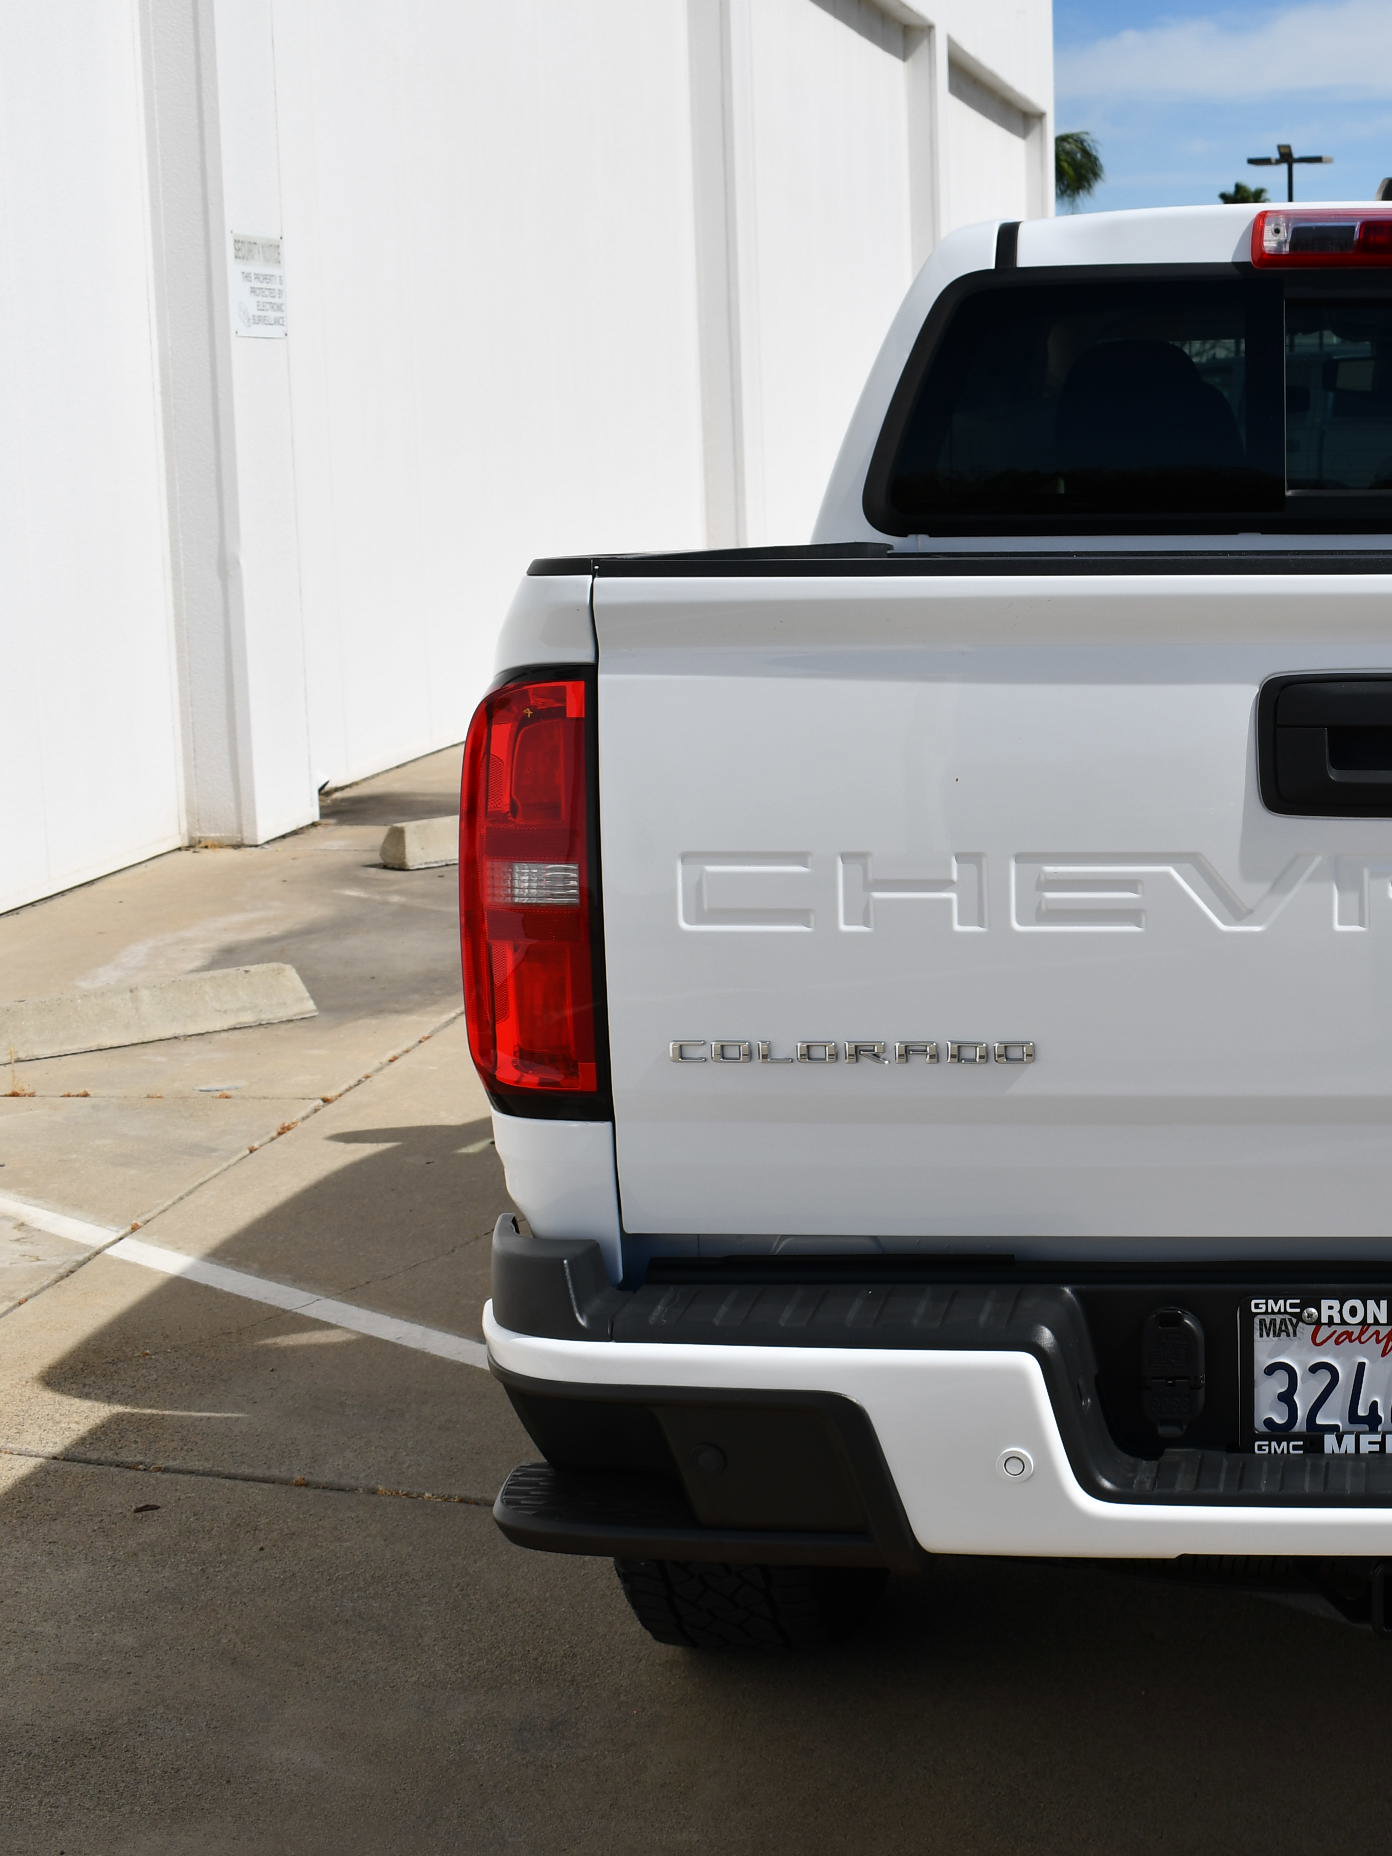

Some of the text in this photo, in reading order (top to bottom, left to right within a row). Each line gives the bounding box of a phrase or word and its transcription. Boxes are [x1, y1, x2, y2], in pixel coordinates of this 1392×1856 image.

[669, 1039, 1036, 1064] COLORADO
[1250, 1299, 1301, 1313] GMC
[1320, 1299, 1388, 1324] RON
[1258, 1318, 1300, 1338] MAY
[1254, 1440, 1304, 1454] GMC
